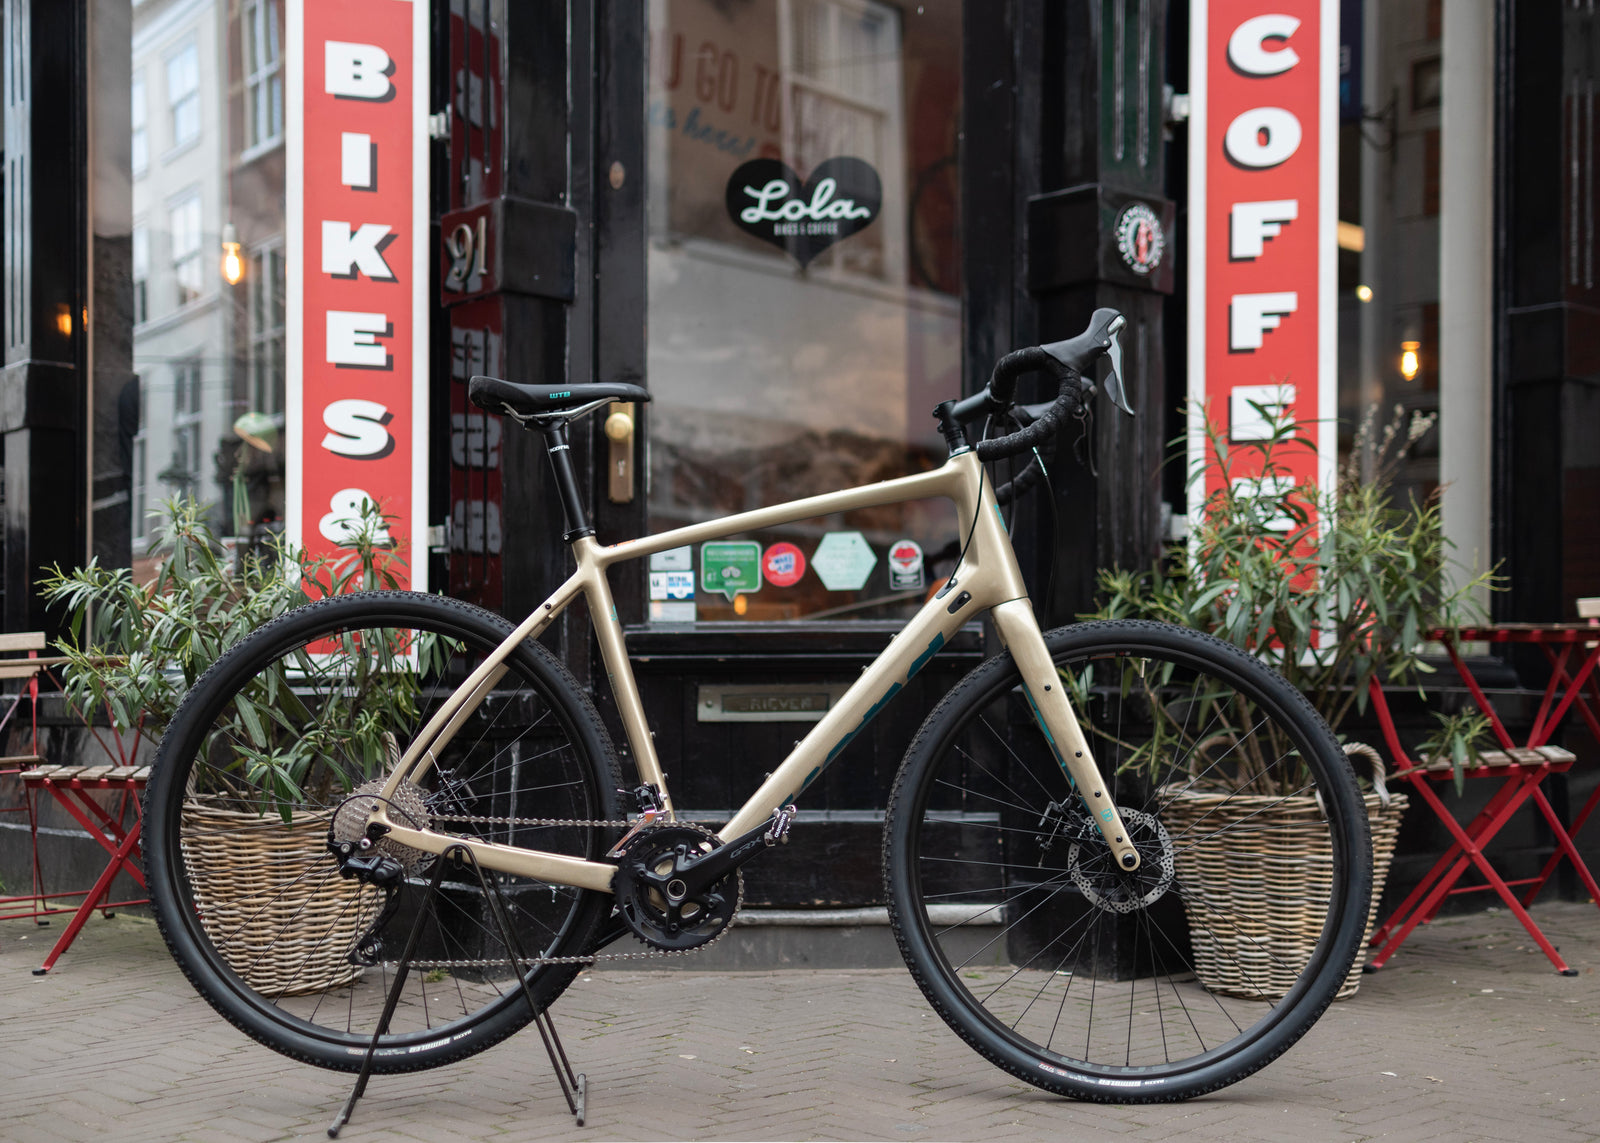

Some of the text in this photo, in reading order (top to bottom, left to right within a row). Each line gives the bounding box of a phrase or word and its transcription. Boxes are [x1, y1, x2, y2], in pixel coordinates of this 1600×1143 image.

[740, 177, 871, 224] Lola
[450, 215, 488, 282] 91
[1224, 14, 1302, 535] COFFEE
[549, 391, 571, 399] WTB
[730, 837, 761, 858] GRX
